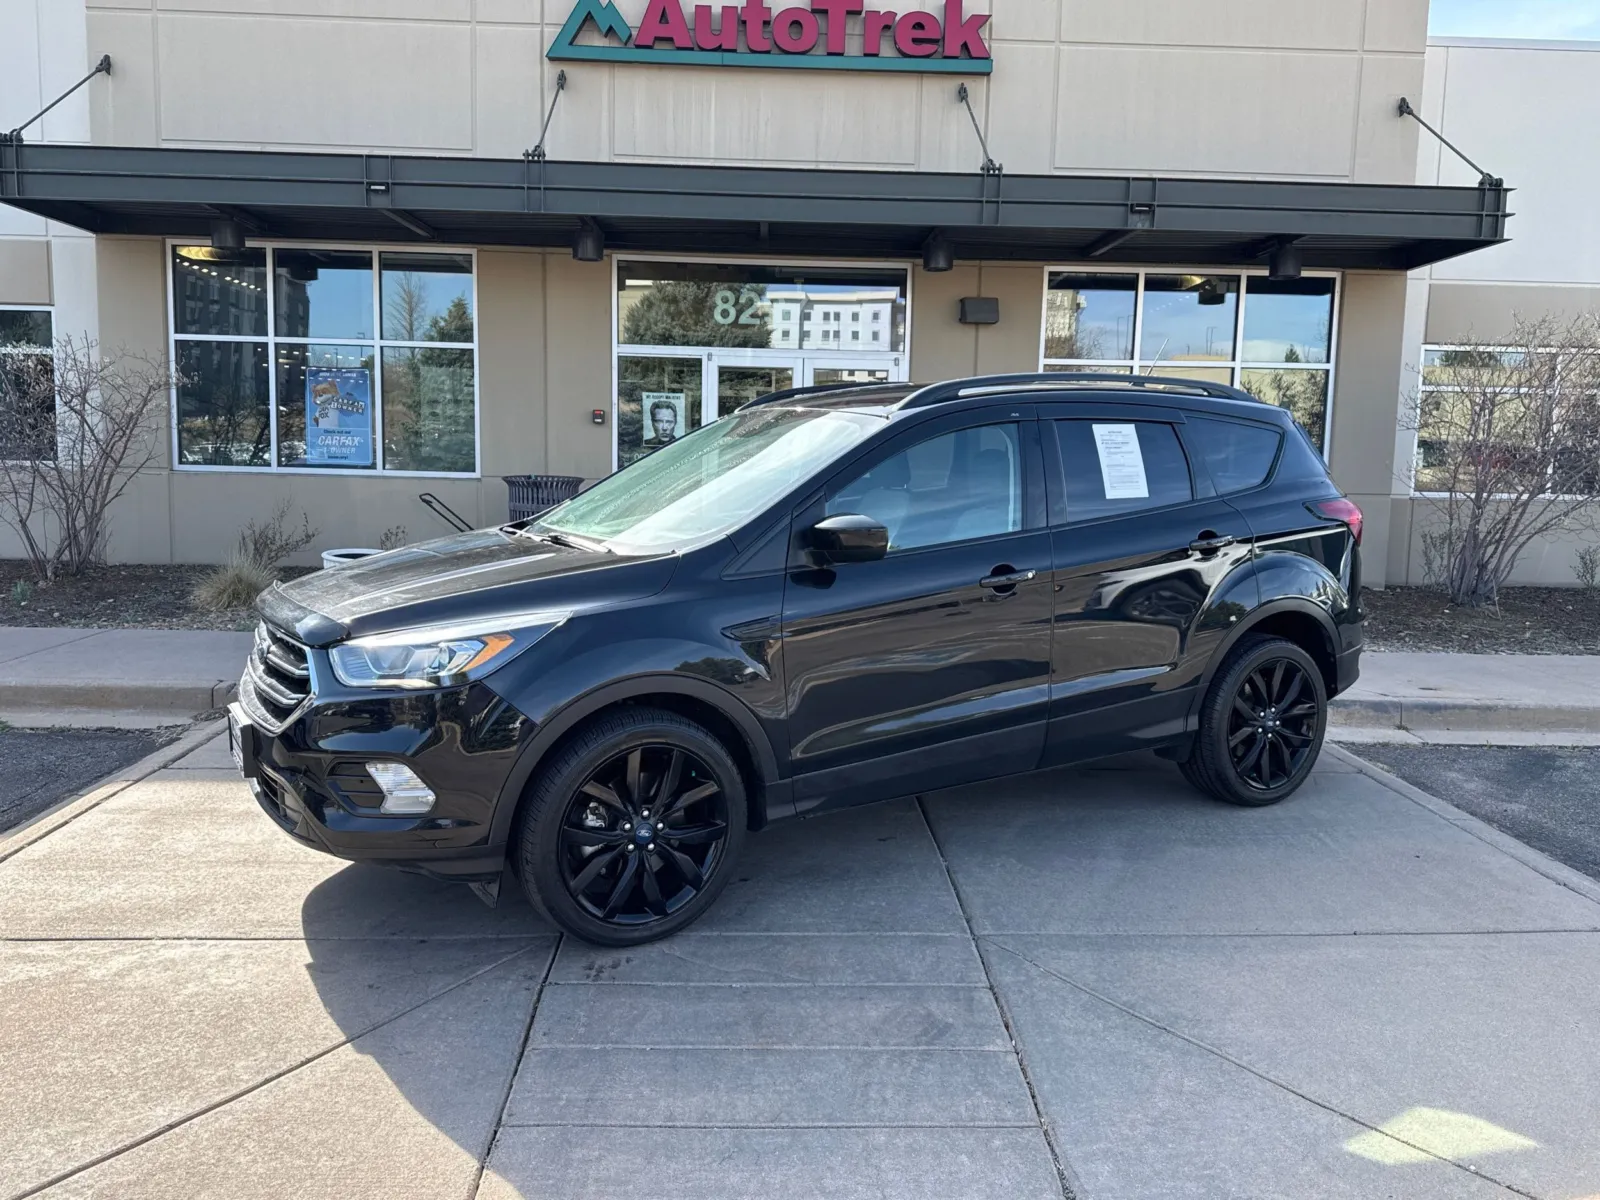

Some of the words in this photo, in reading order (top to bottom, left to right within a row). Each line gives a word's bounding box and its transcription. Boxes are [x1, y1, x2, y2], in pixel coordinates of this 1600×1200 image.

[633, 0, 992, 58] AutoTrek
[713, 290, 761, 325] 82
[318, 435, 361, 447] CARFAX
